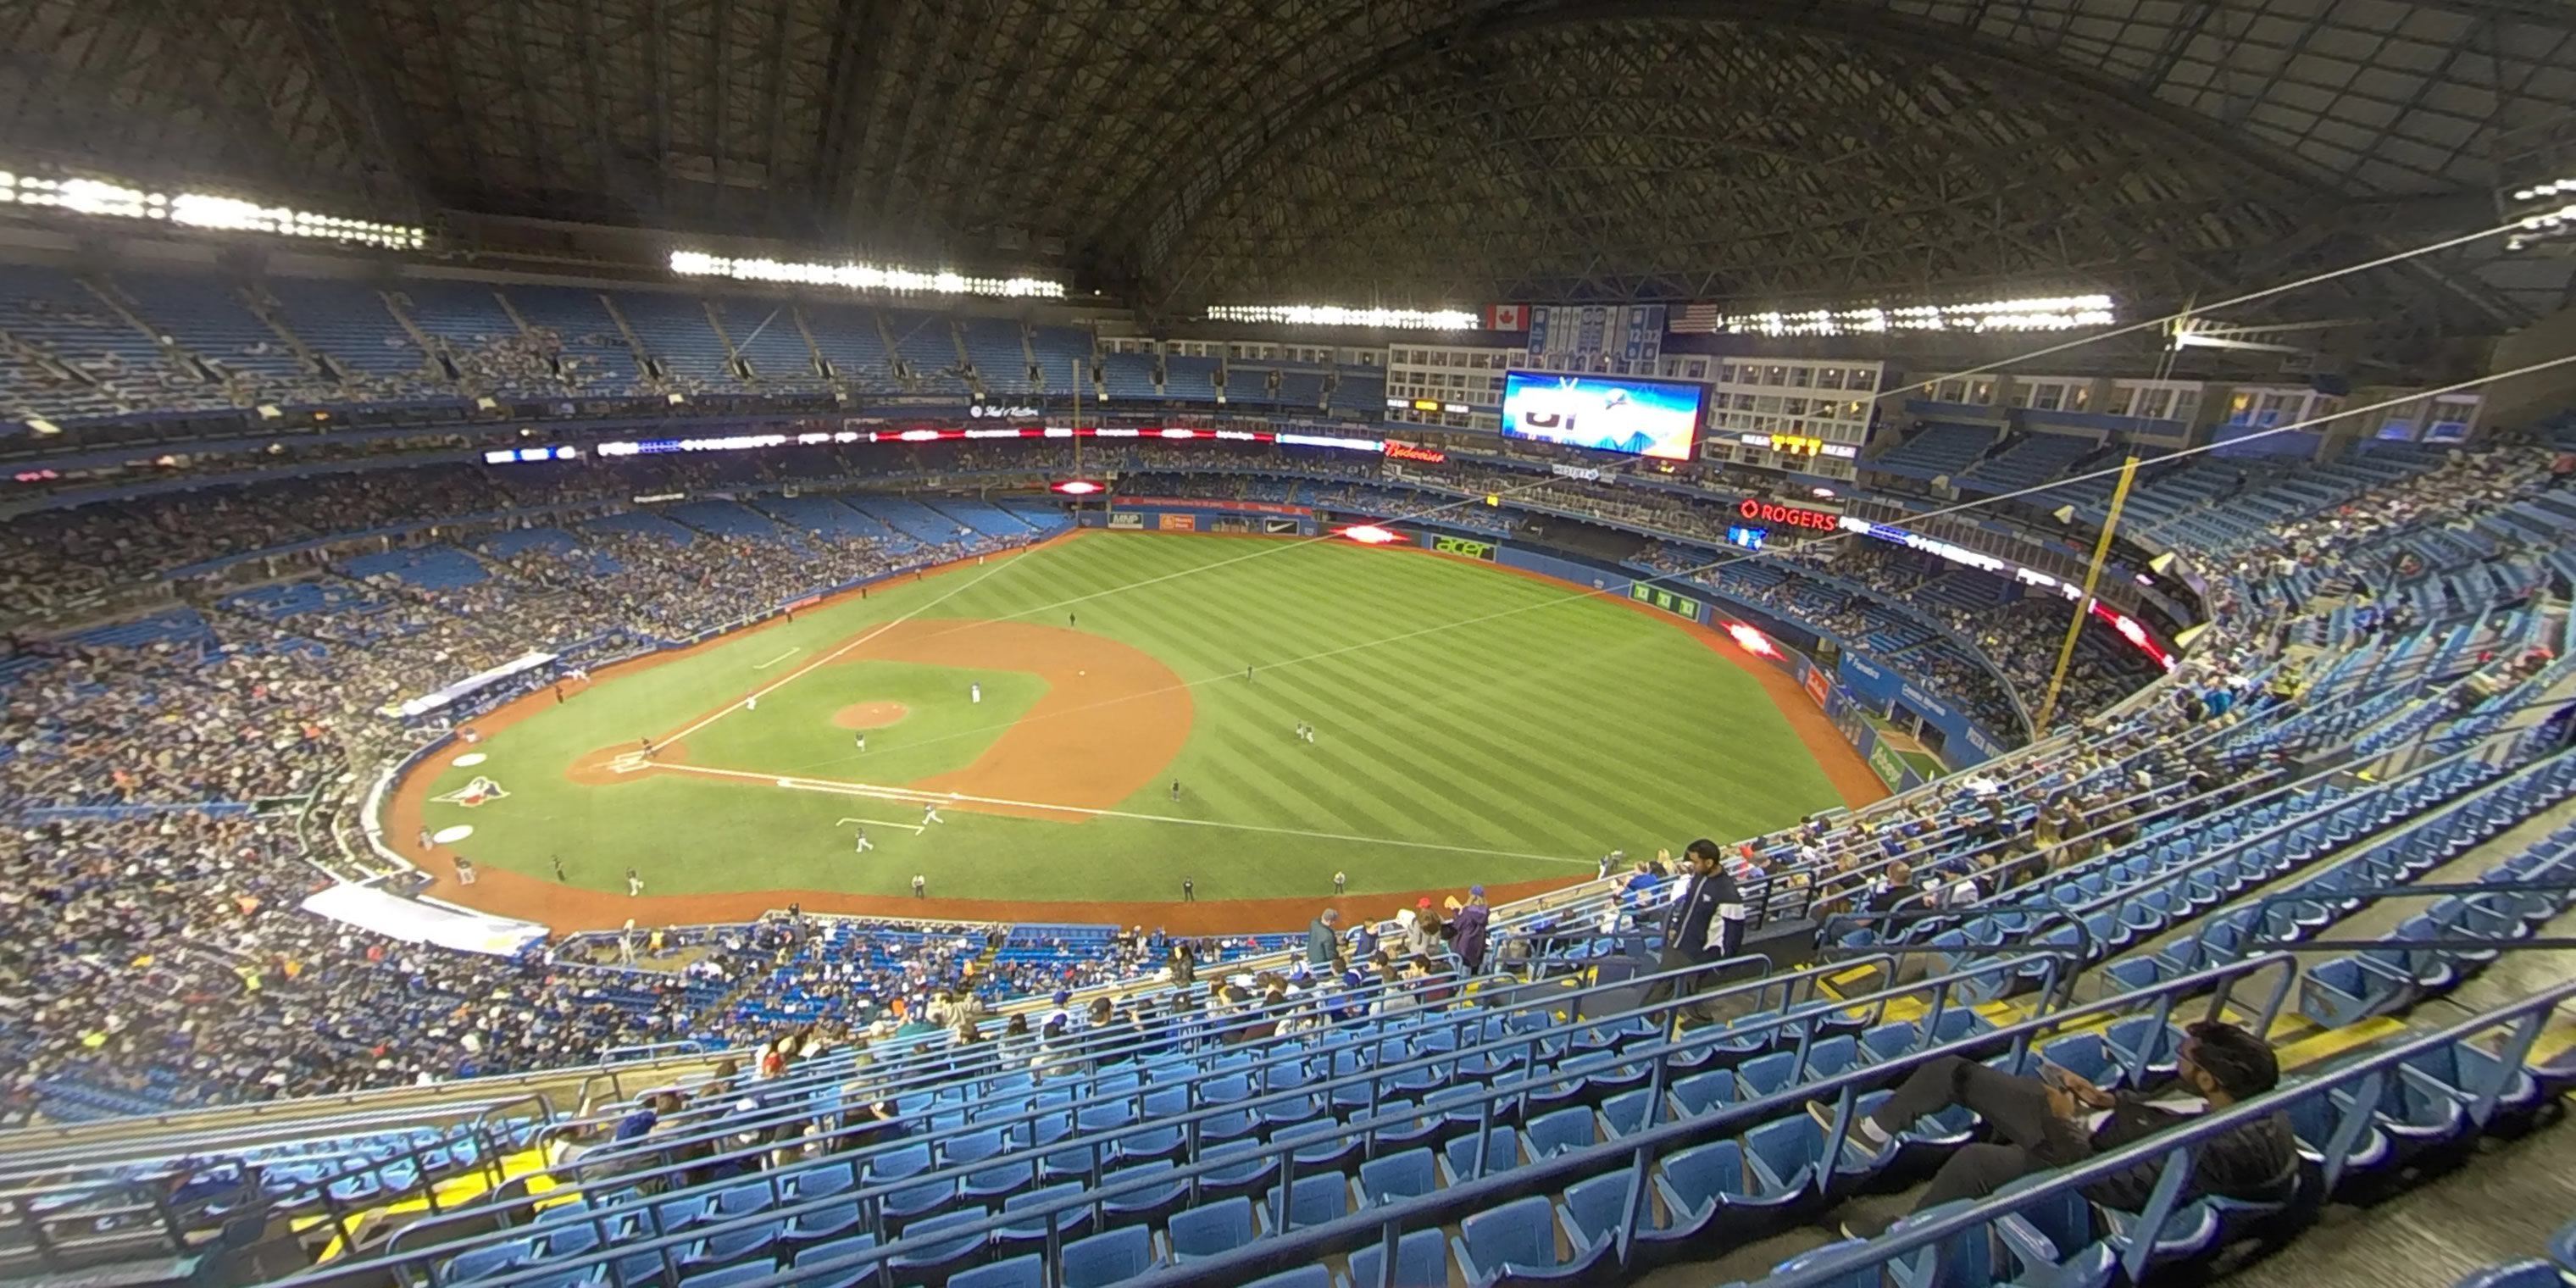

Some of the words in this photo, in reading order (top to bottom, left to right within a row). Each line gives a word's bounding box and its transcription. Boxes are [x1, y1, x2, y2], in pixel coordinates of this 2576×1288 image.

[1385, 441, 1445, 463] Budweiser
[1113, 514, 1139, 525] MNP
[1762, 504, 1836, 531] ROGERS
[1436, 536, 1491, 558] acer
[1852, 658, 1880, 680] Fanatics
